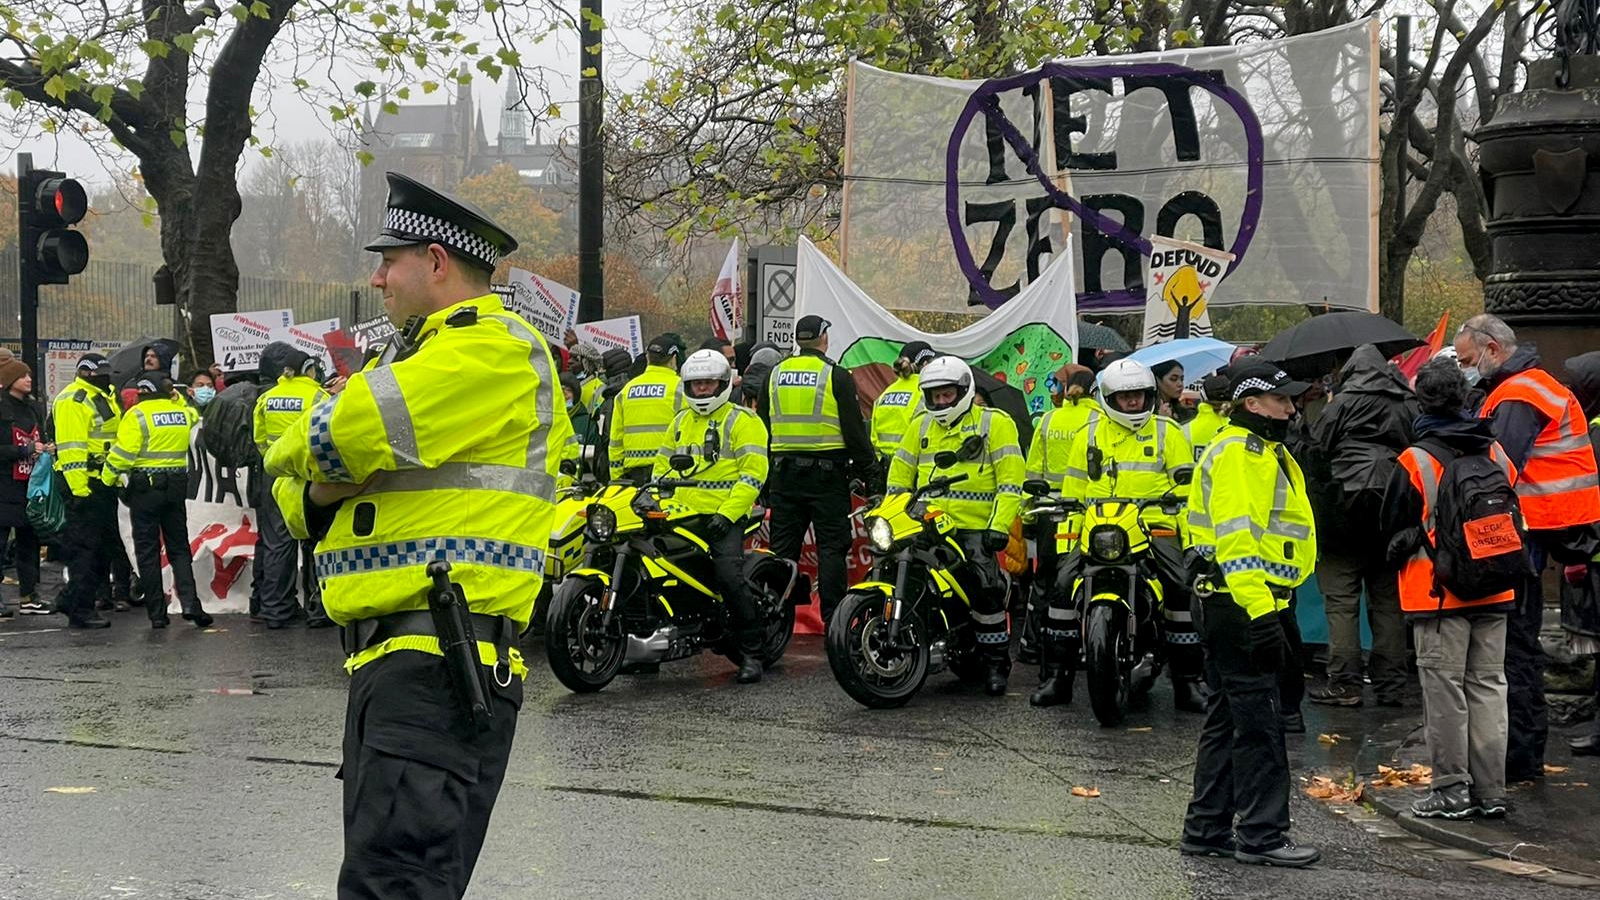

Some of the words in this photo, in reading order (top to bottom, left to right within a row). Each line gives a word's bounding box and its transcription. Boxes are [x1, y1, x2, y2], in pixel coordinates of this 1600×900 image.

[980, 70, 1227, 185] NET
[964, 189, 1225, 306] ZERO
[1150, 249, 1222, 278] DEFUND
[772, 320, 791, 329] Zone
[767, 332, 794, 344] ENDS
[48, 341, 69, 350] FALUN
[70, 342, 88, 350] DAFA
[223, 352, 237, 369] 4
[778, 372, 817, 386] POLICE
[629, 385, 665, 398] POLICE
[267, 398, 301, 410] POLICE
[153, 413, 186, 425] POLICE
[1048, 430, 1076, 440] POLIC
